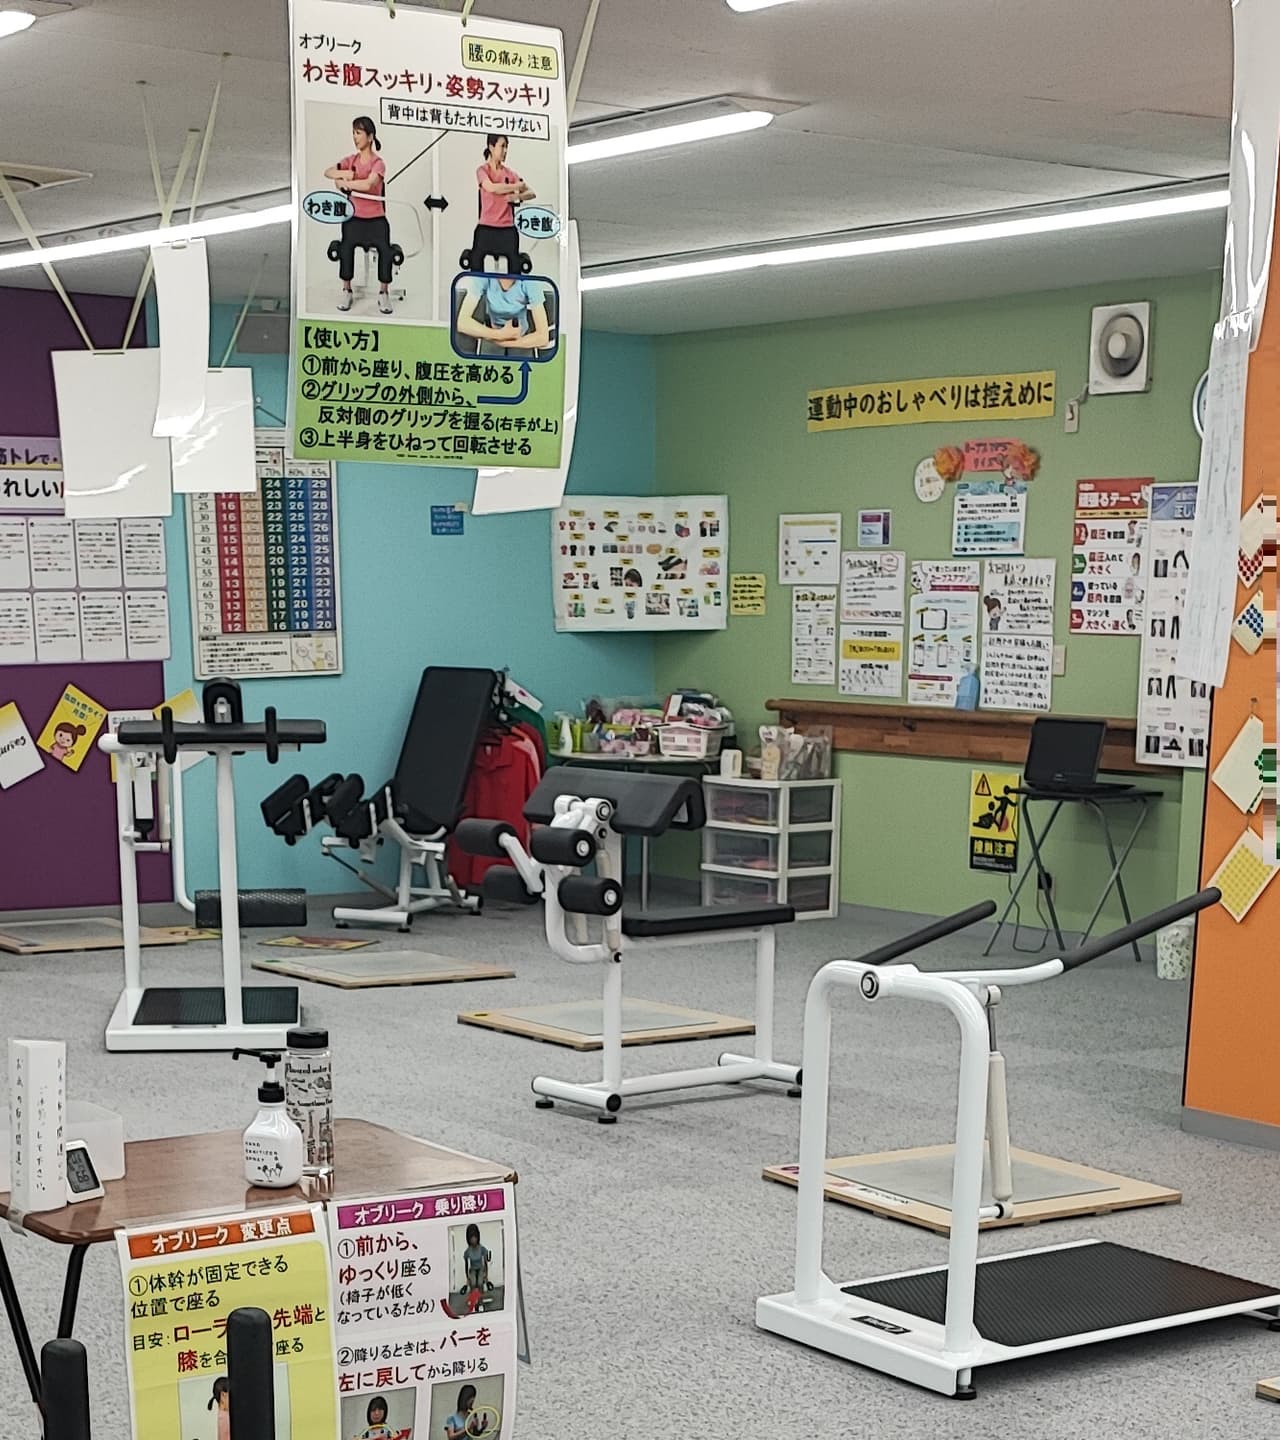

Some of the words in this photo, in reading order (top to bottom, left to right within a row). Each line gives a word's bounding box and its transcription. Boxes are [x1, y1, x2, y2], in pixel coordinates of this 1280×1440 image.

[299, 35, 362, 55] オブリーク
[468, 42, 523, 70] 腰の痛み
[527, 52, 554, 72] 注意
[302, 60, 552, 108] わき腹スッキリ・姿勢スッキリ
[388, 103, 542, 134] 背中は背もたれにつけない
[307, 201, 348, 217] わき腹
[517, 214, 555, 233] わき腹
[303, 327, 380, 353] 【使い方】
[302, 357, 515, 386] ①前から座り、腹圧を高める
[807, 381, 1053, 421] 運動中のおしゃべりは控えめに
[300, 430, 532, 456] ③上半身をひねって回転させる
[266, 480, 280, 488] 24
[288, 479, 303, 488] 27
[312, 479, 327, 488] 29
[266, 491, 281, 499] 23
[289, 490, 304, 499] 27
[312, 490, 327, 499] 28
[267, 502, 281, 510] 23
[289, 502, 304, 510] 26
[312, 502, 328, 510] 28
[267, 513, 282, 521] 22
[290, 513, 305, 521] 25
[313, 513, 328, 521] 27
[268, 525, 282, 533] 22
[290, 524, 305, 533] 25
[313, 524, 328, 532] 26
[269, 536, 283, 544] 21
[291, 535, 306, 544] 24
[314, 535, 329, 543] 26
[269, 546, 283, 554] 20
[292, 546, 306, 554] 23
[314, 546, 329, 554] 25
[270, 558, 284, 566] 20
[292, 557, 306, 565] 23
[314, 557, 329, 565] 24
[270, 569, 284, 577] 19
[293, 568, 307, 576] 22
[315, 568, 330, 576] 23
[271, 579, 285, 587] 19
[293, 579, 307, 587] 21
[315, 579, 330, 587] 23
[272, 590, 285, 598] 18
[294, 590, 308, 598] 21
[316, 589, 330, 598] 22
[272, 601, 286, 609] 18
[294, 601, 308, 609] 20
[316, 600, 331, 608] 21
[227, 613, 240, 621] 12
[273, 612, 286, 620] 17
[295, 611, 308, 619] 19
[316, 611, 331, 619] 21
[274, 622, 286, 630] 16
[295, 622, 309, 630] 19
[317, 621, 332, 629] 20
[355, 1203, 424, 1225] オブリーク
[435, 1193, 488, 1215] 乗り降り
[152, 1225, 229, 1253] オブリーク
[240, 1216, 292, 1242] 変更点
[337, 1231, 418, 1258] ①前から、
[129, 1254, 288, 1297] ①体幹が固定できる
[339, 1257, 432, 1285] ゆっくり座る
[131, 1289, 220, 1319] 位置で座る
[340, 1282, 414, 1305] (椅子が低く
[337, 1298, 435, 1324] なっているため)
[337, 1328, 491, 1366] ②降りるときは、バーを
[338, 1358, 489, 1393] 左に戻してから降りる
